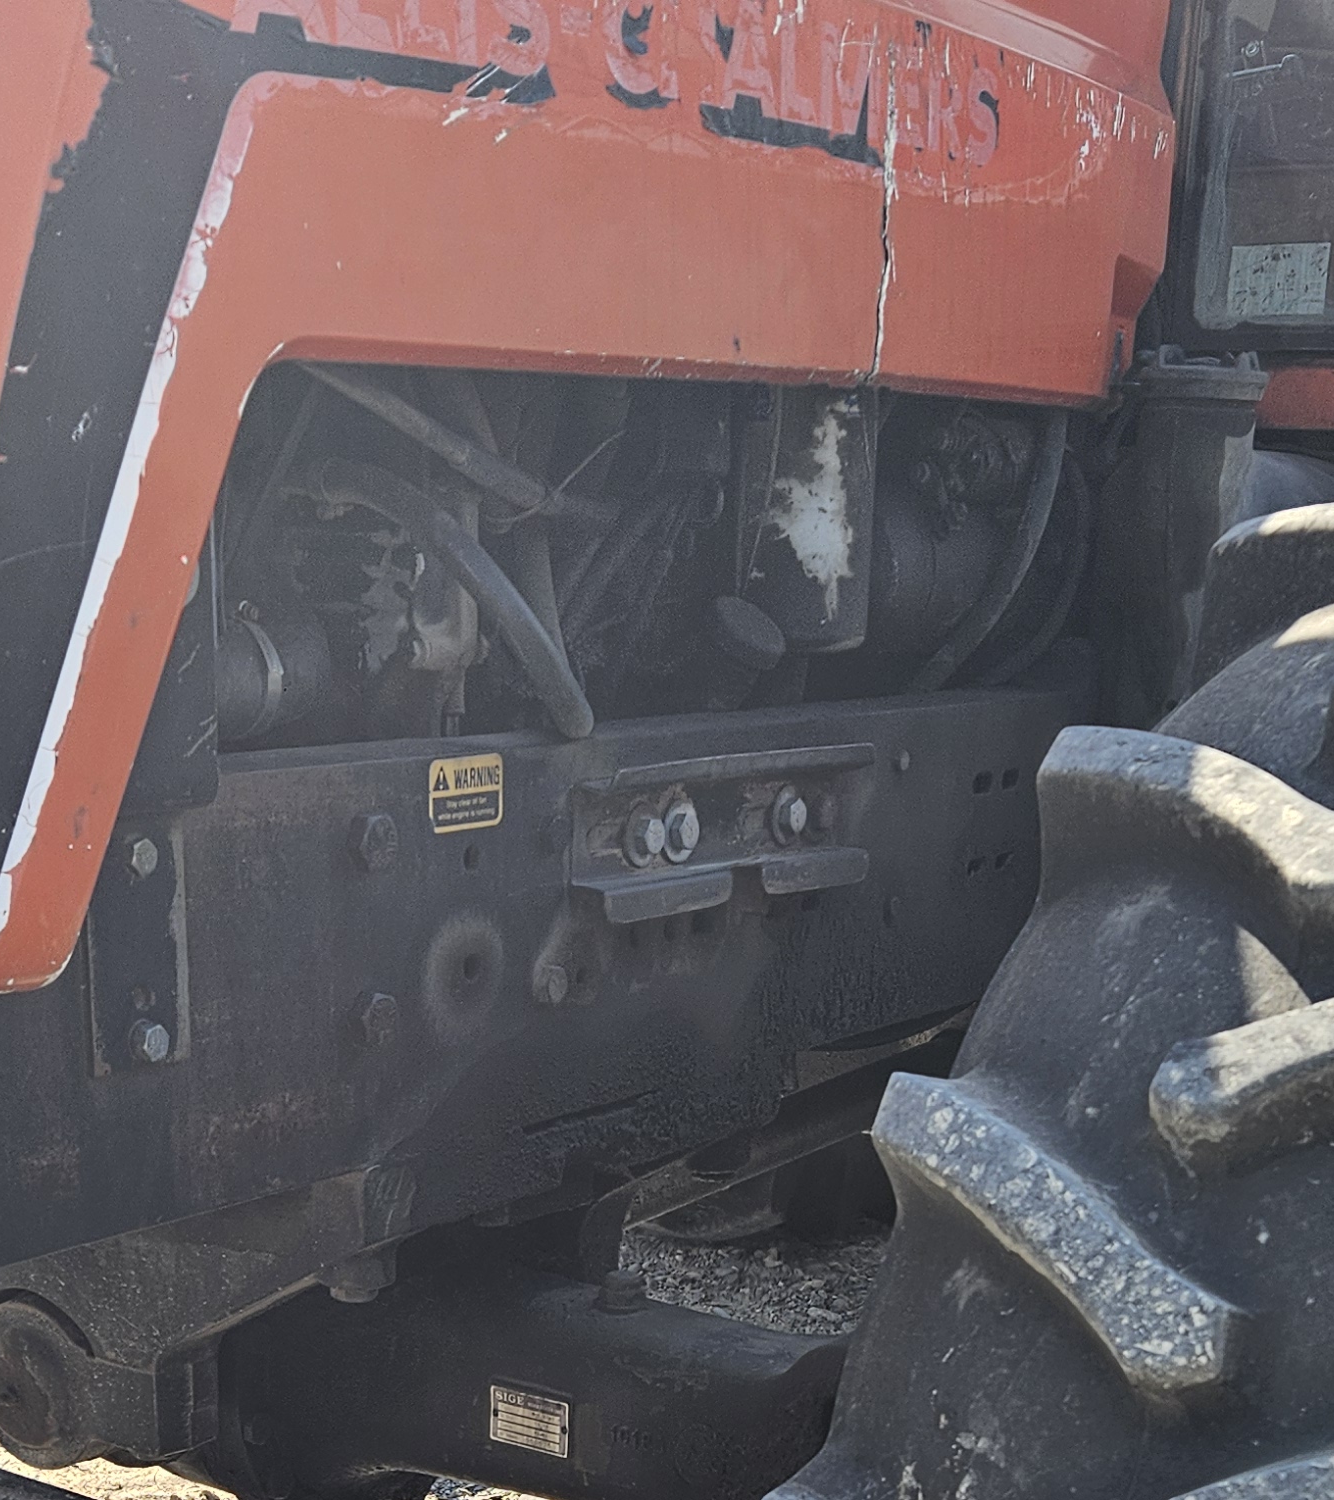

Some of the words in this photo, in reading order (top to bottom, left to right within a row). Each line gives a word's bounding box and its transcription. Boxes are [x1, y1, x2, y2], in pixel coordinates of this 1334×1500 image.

[229, 0, 999, 167] IS-CALMERS
[454, 765, 500, 789] WARNING
[495, 1391, 524, 1405] SIGE
